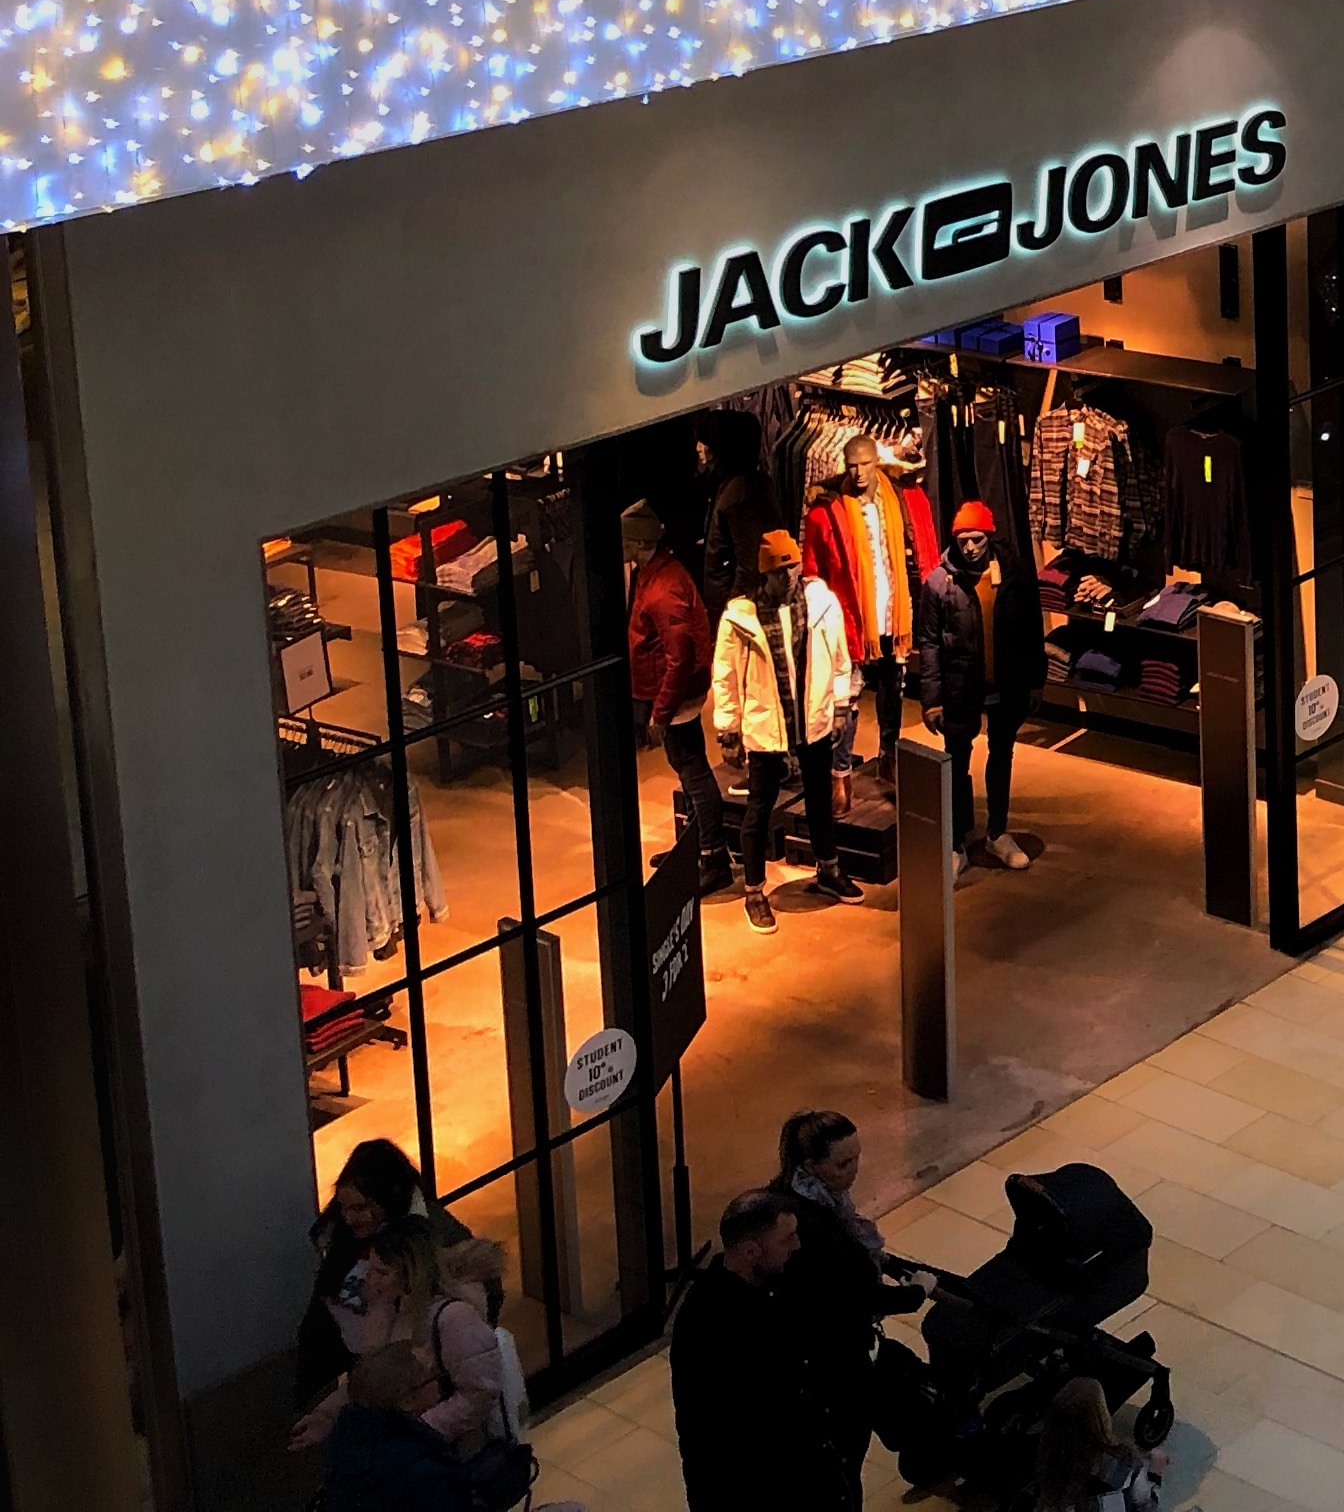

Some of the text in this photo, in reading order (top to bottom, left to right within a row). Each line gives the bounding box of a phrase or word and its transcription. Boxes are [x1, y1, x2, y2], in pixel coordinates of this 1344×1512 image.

[639, 109, 1288, 365] JACK JONES
[576, 1037, 623, 1071] STUDENT
[578, 1069, 624, 1102] DISCOUNT
